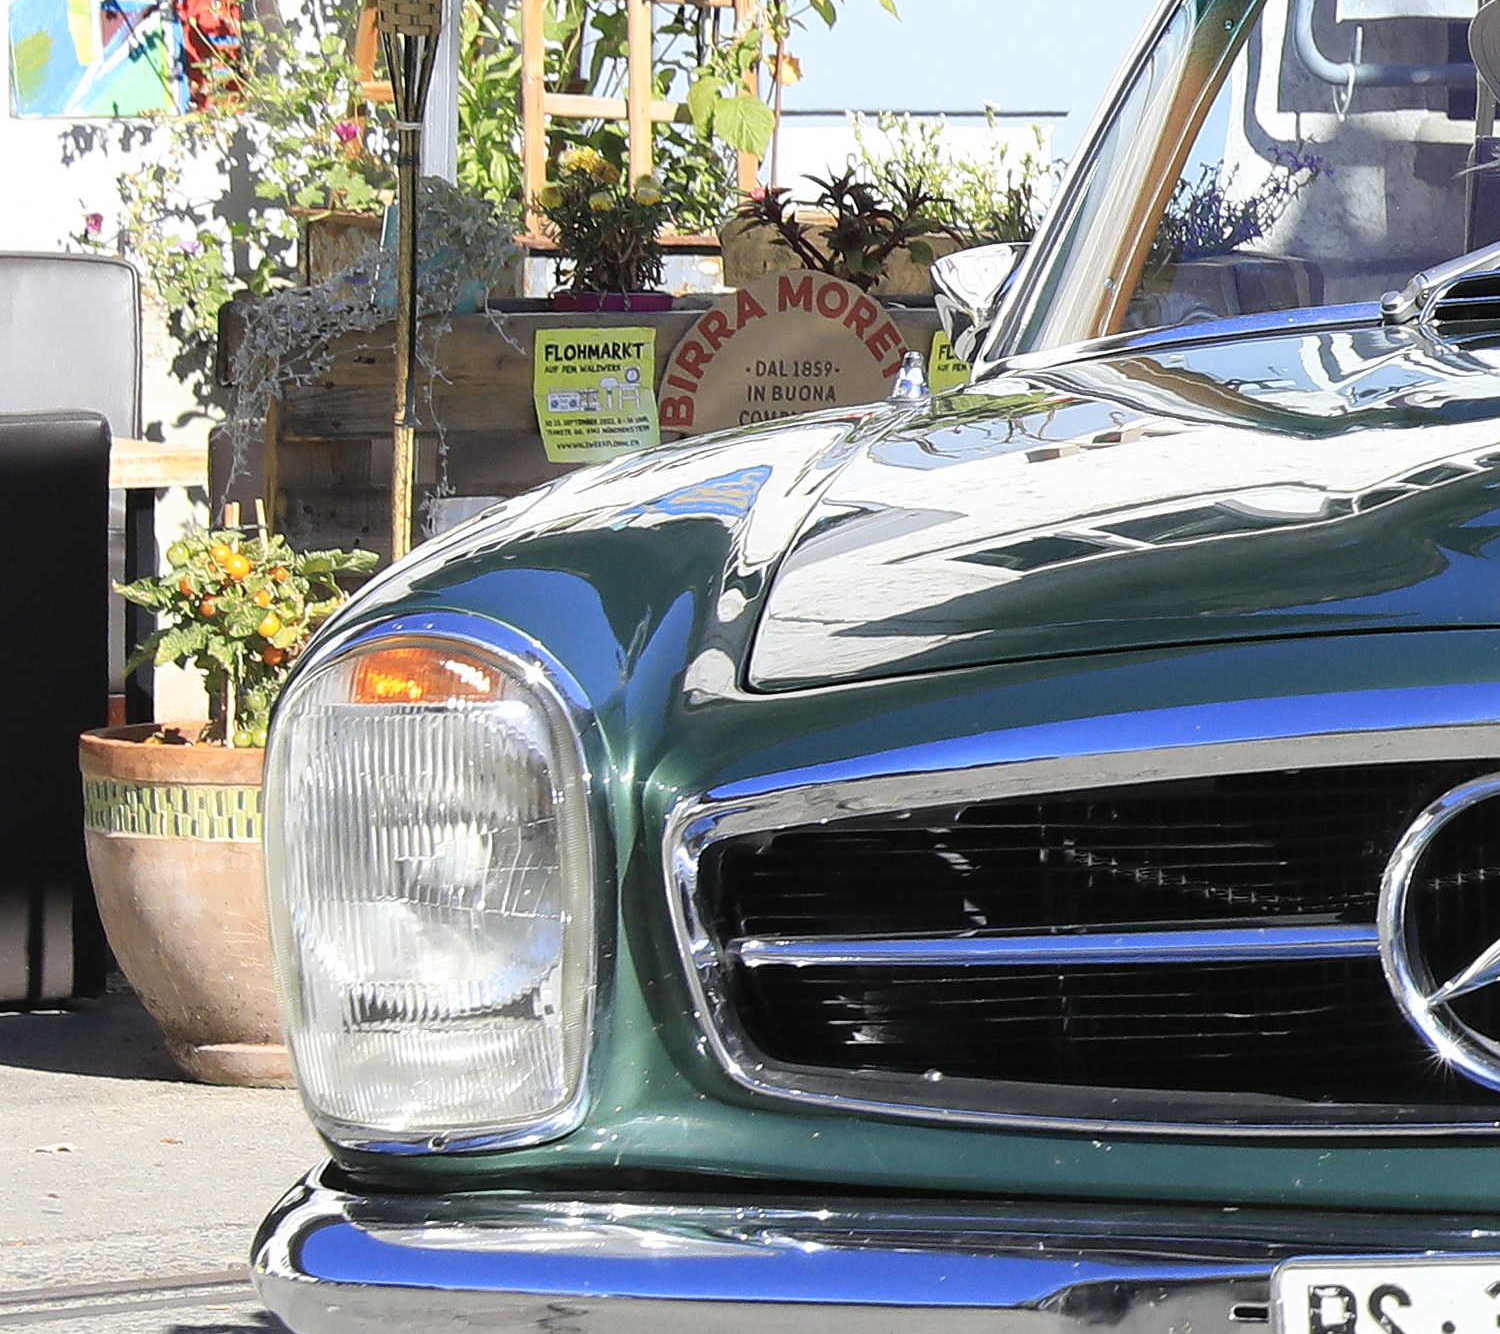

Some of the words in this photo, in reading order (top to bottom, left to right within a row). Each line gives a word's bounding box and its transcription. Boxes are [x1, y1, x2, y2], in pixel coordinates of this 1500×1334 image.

[544, 342, 644, 362] FLOHMARKT
[660, 287, 768, 427] BIRRA
[755, 359, 788, 377] DAL
[747, 384, 766, 402] IN
[772, 384, 837, 402] BUONA
